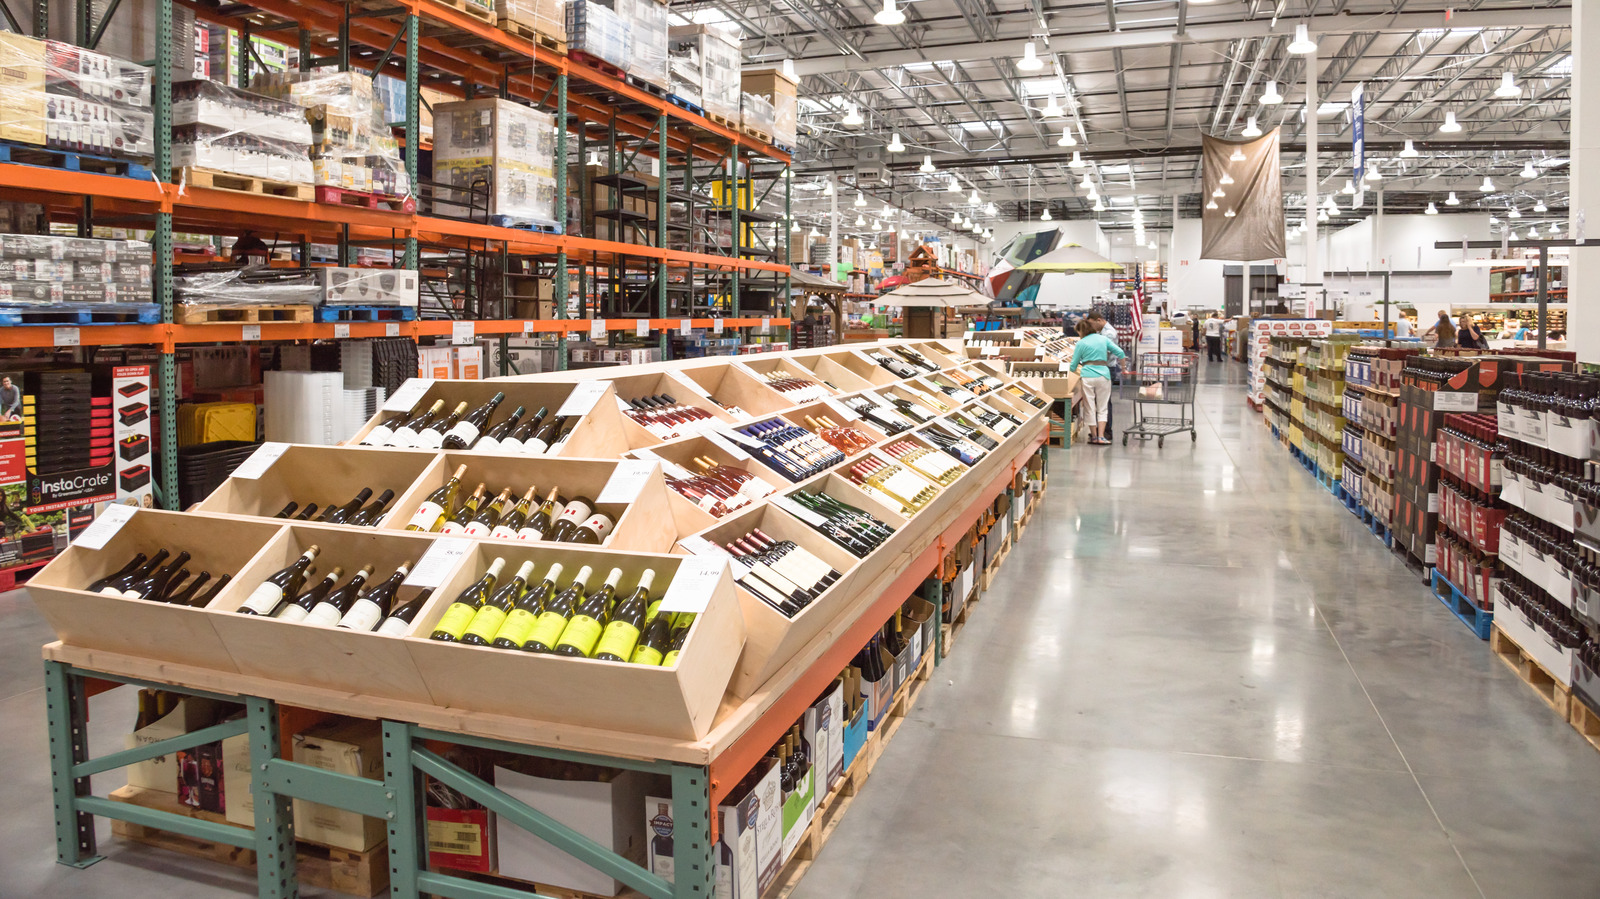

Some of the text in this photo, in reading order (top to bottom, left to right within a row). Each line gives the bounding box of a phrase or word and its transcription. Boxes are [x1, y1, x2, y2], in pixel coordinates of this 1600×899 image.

[80, 265, 100, 274] Silver
[120, 266, 140, 275] Silver
[41, 473, 109, 494] InstaCrate
[45, 502, 67, 511] INSTANT
[67, 498, 89, 507] STORAGE
[653, 820, 673, 828] IMPACT
